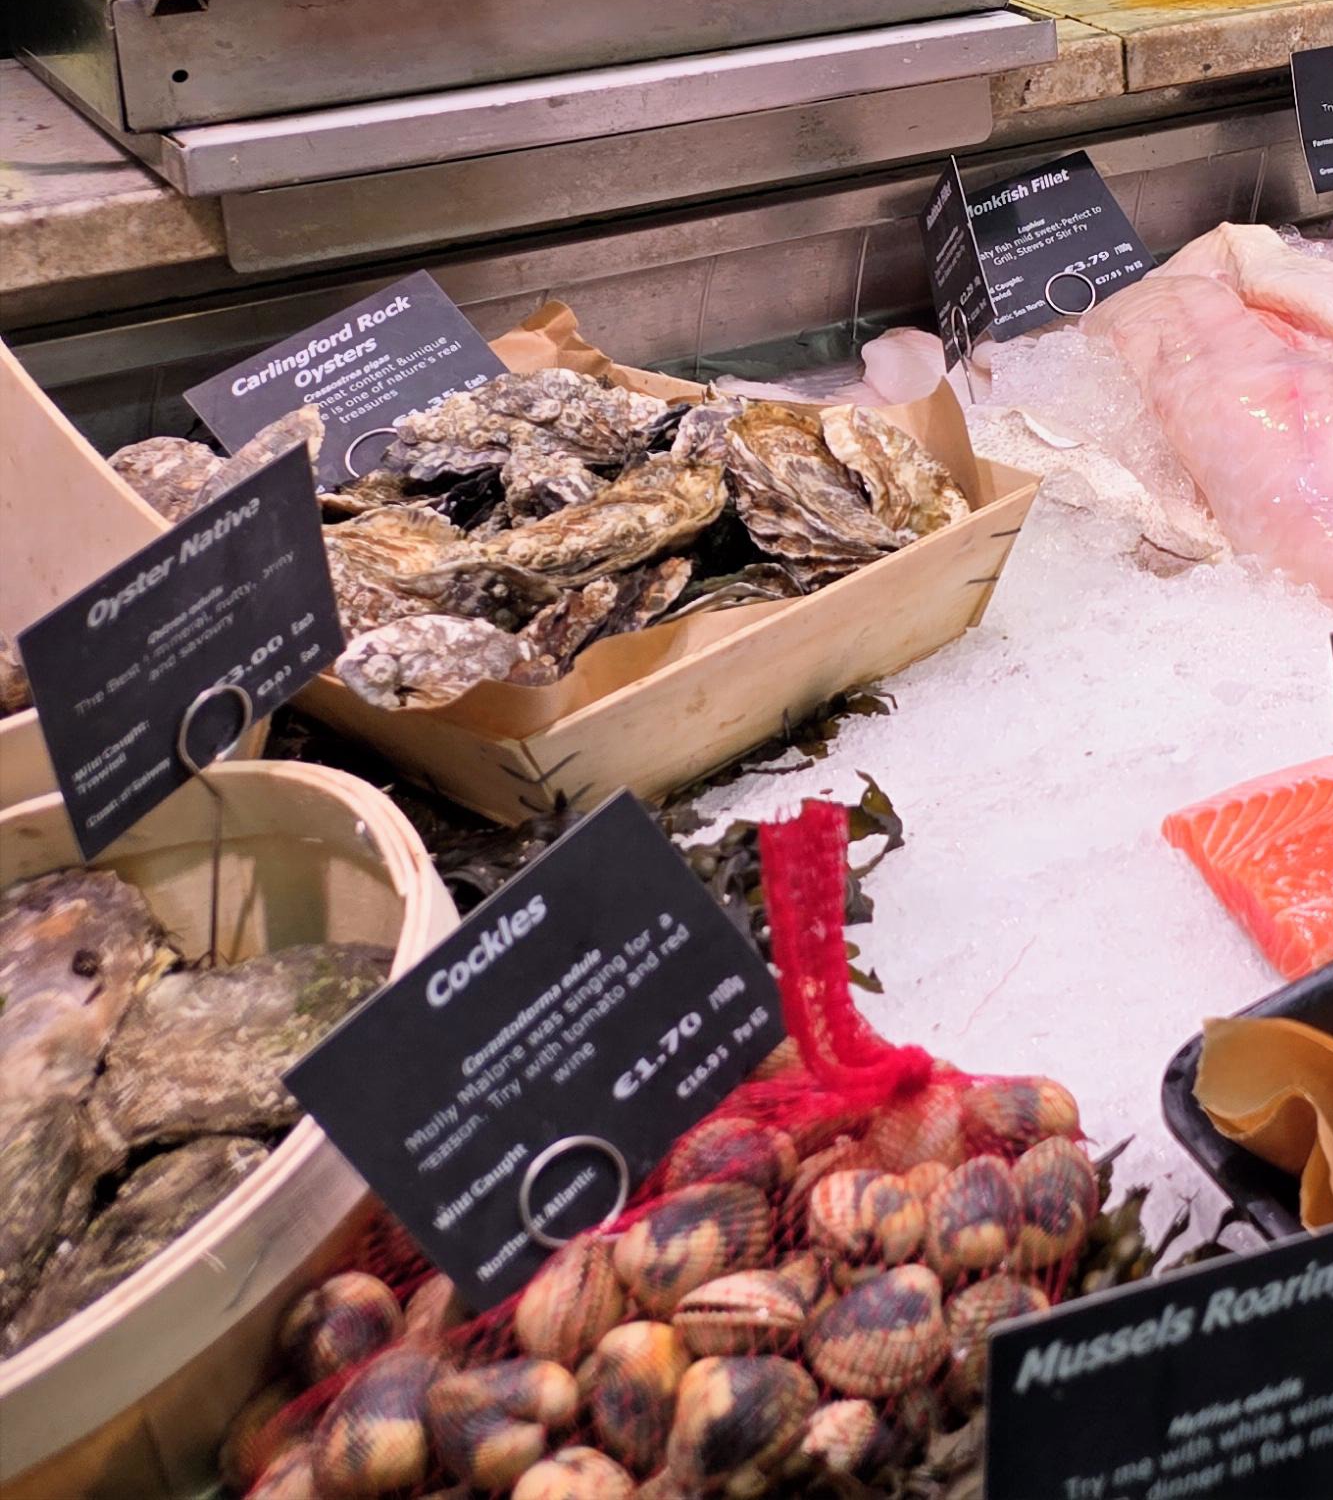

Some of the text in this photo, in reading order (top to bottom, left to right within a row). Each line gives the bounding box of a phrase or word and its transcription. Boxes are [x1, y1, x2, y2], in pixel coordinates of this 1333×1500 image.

[1031, 168, 1070, 193] Fillet
[993, 223, 1088, 267] Grill, Stews or Stir Fry
[996, 206, 1102, 254] fish mild to
[231, 294, 412, 396] Carlingford Rock
[294, 336, 378, 389] Oysters
[303, 365, 363, 404] Crassostrea
[331, 404, 345, 416] is
[345, 391, 370, 410] one
[371, 381, 385, 400] of
[386, 353, 437, 391] nature's
[437, 340, 462, 362] real
[349, 363, 396, 395] content
[339, 388, 399, 425] treasures
[86, 555, 177, 628] Oyster
[178, 497, 260, 565] Native
[426, 894, 548, 1008] Cockles
[524, 1040, 564, 1081] with
[562, 984, 626, 1043] tomato
[626, 950, 660, 988] and
[659, 922, 690, 956] red
[404, 912, 674, 1154] Molly Malone was singing for a
[612, 1011, 703, 1100] €1.70
[552, 1041, 596, 1085] wine
[471, 1142, 529, 1198] Caught
[1013, 1302, 1197, 1395] Mussels
